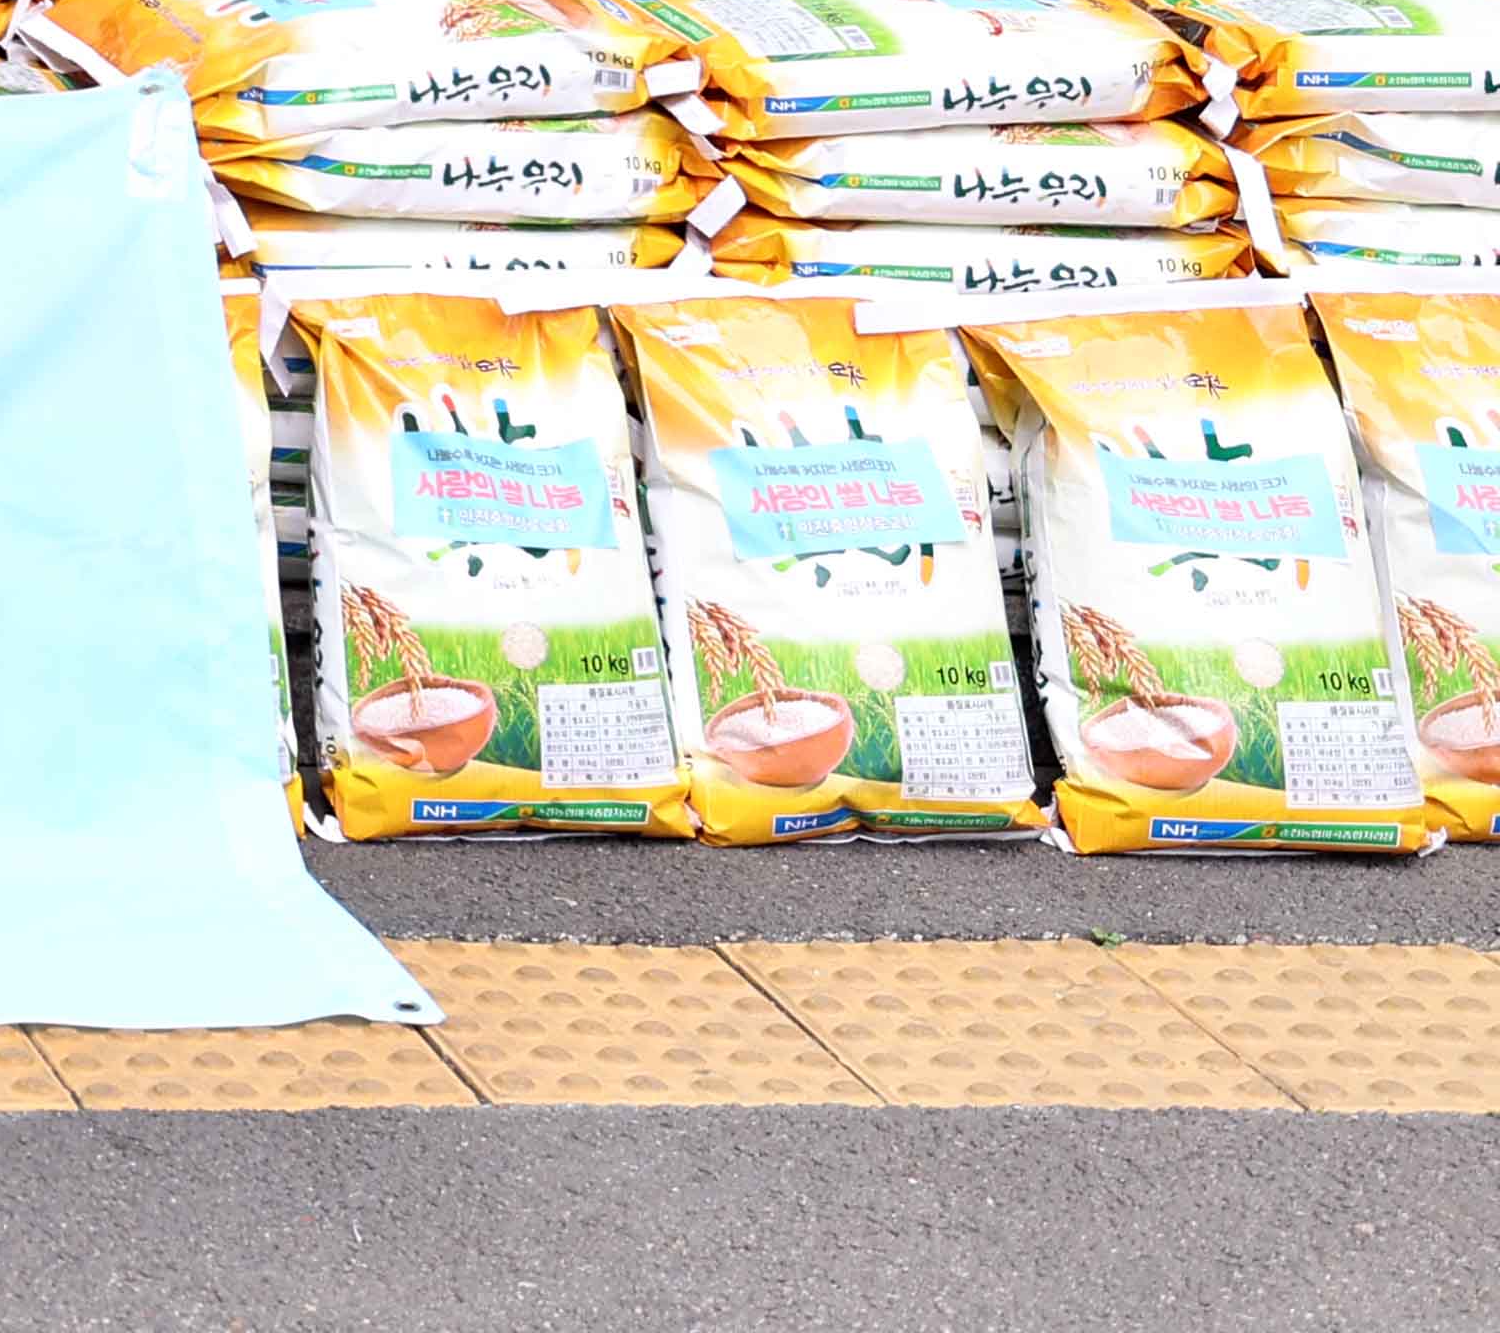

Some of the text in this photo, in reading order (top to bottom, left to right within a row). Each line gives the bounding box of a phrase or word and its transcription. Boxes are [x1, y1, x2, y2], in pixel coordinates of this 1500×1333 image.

[416, 471, 584, 510] 사랑의 쌀 나눔
[1131, 489, 1311, 522] 사랑의 쌀 나눔
[580, 654, 629, 677] 10 kg
[1318, 669, 1371, 695] 10 kg
[421, 804, 457, 820] NH
[1162, 823, 1198, 838] NH
